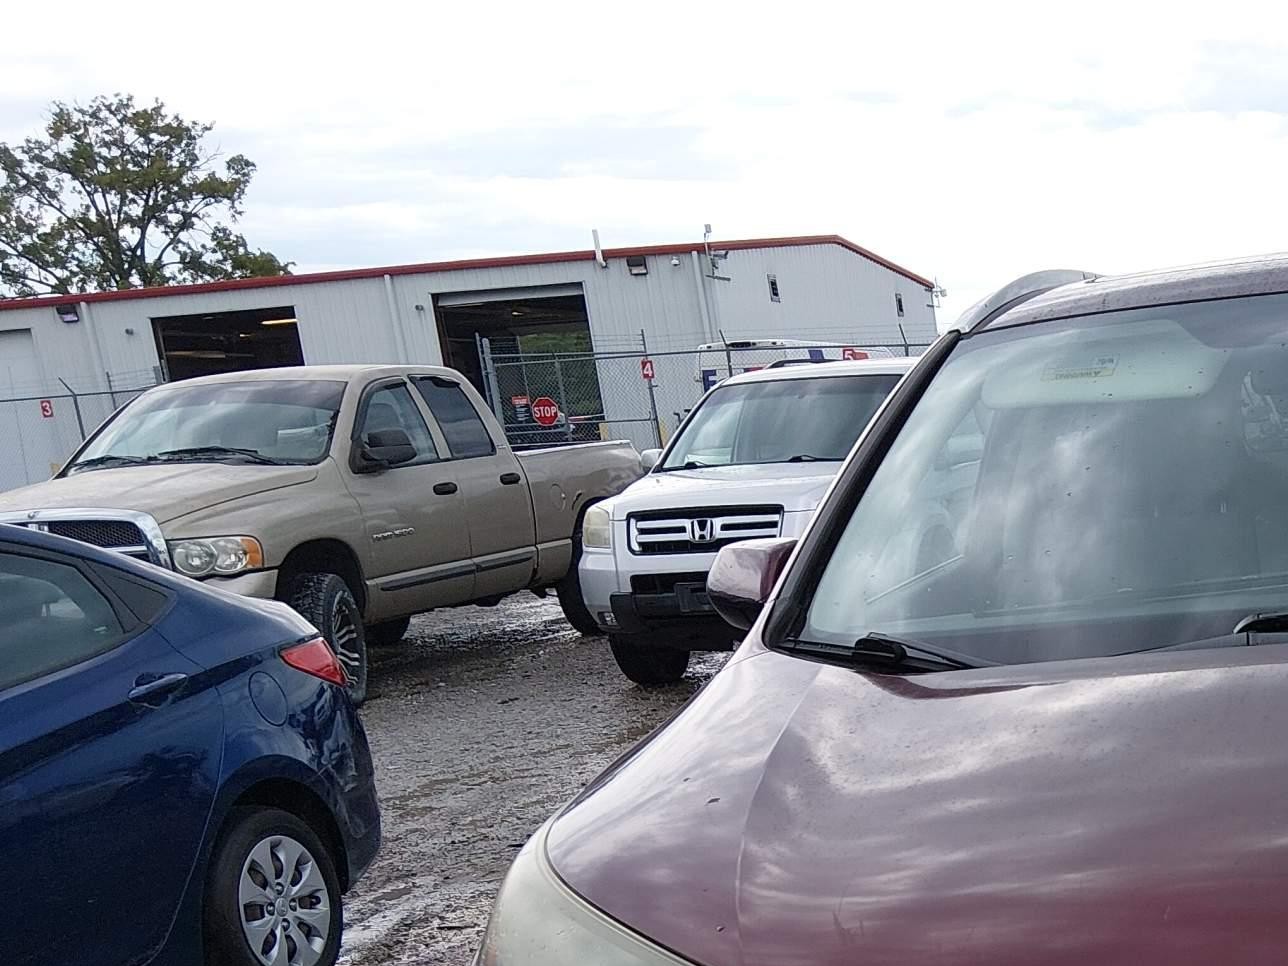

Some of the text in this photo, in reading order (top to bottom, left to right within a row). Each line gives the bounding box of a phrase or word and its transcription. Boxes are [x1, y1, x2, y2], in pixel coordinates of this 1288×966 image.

[643, 362, 653, 377] 4
[42, 402, 52, 416] 3
[534, 406, 557, 418] STOP
